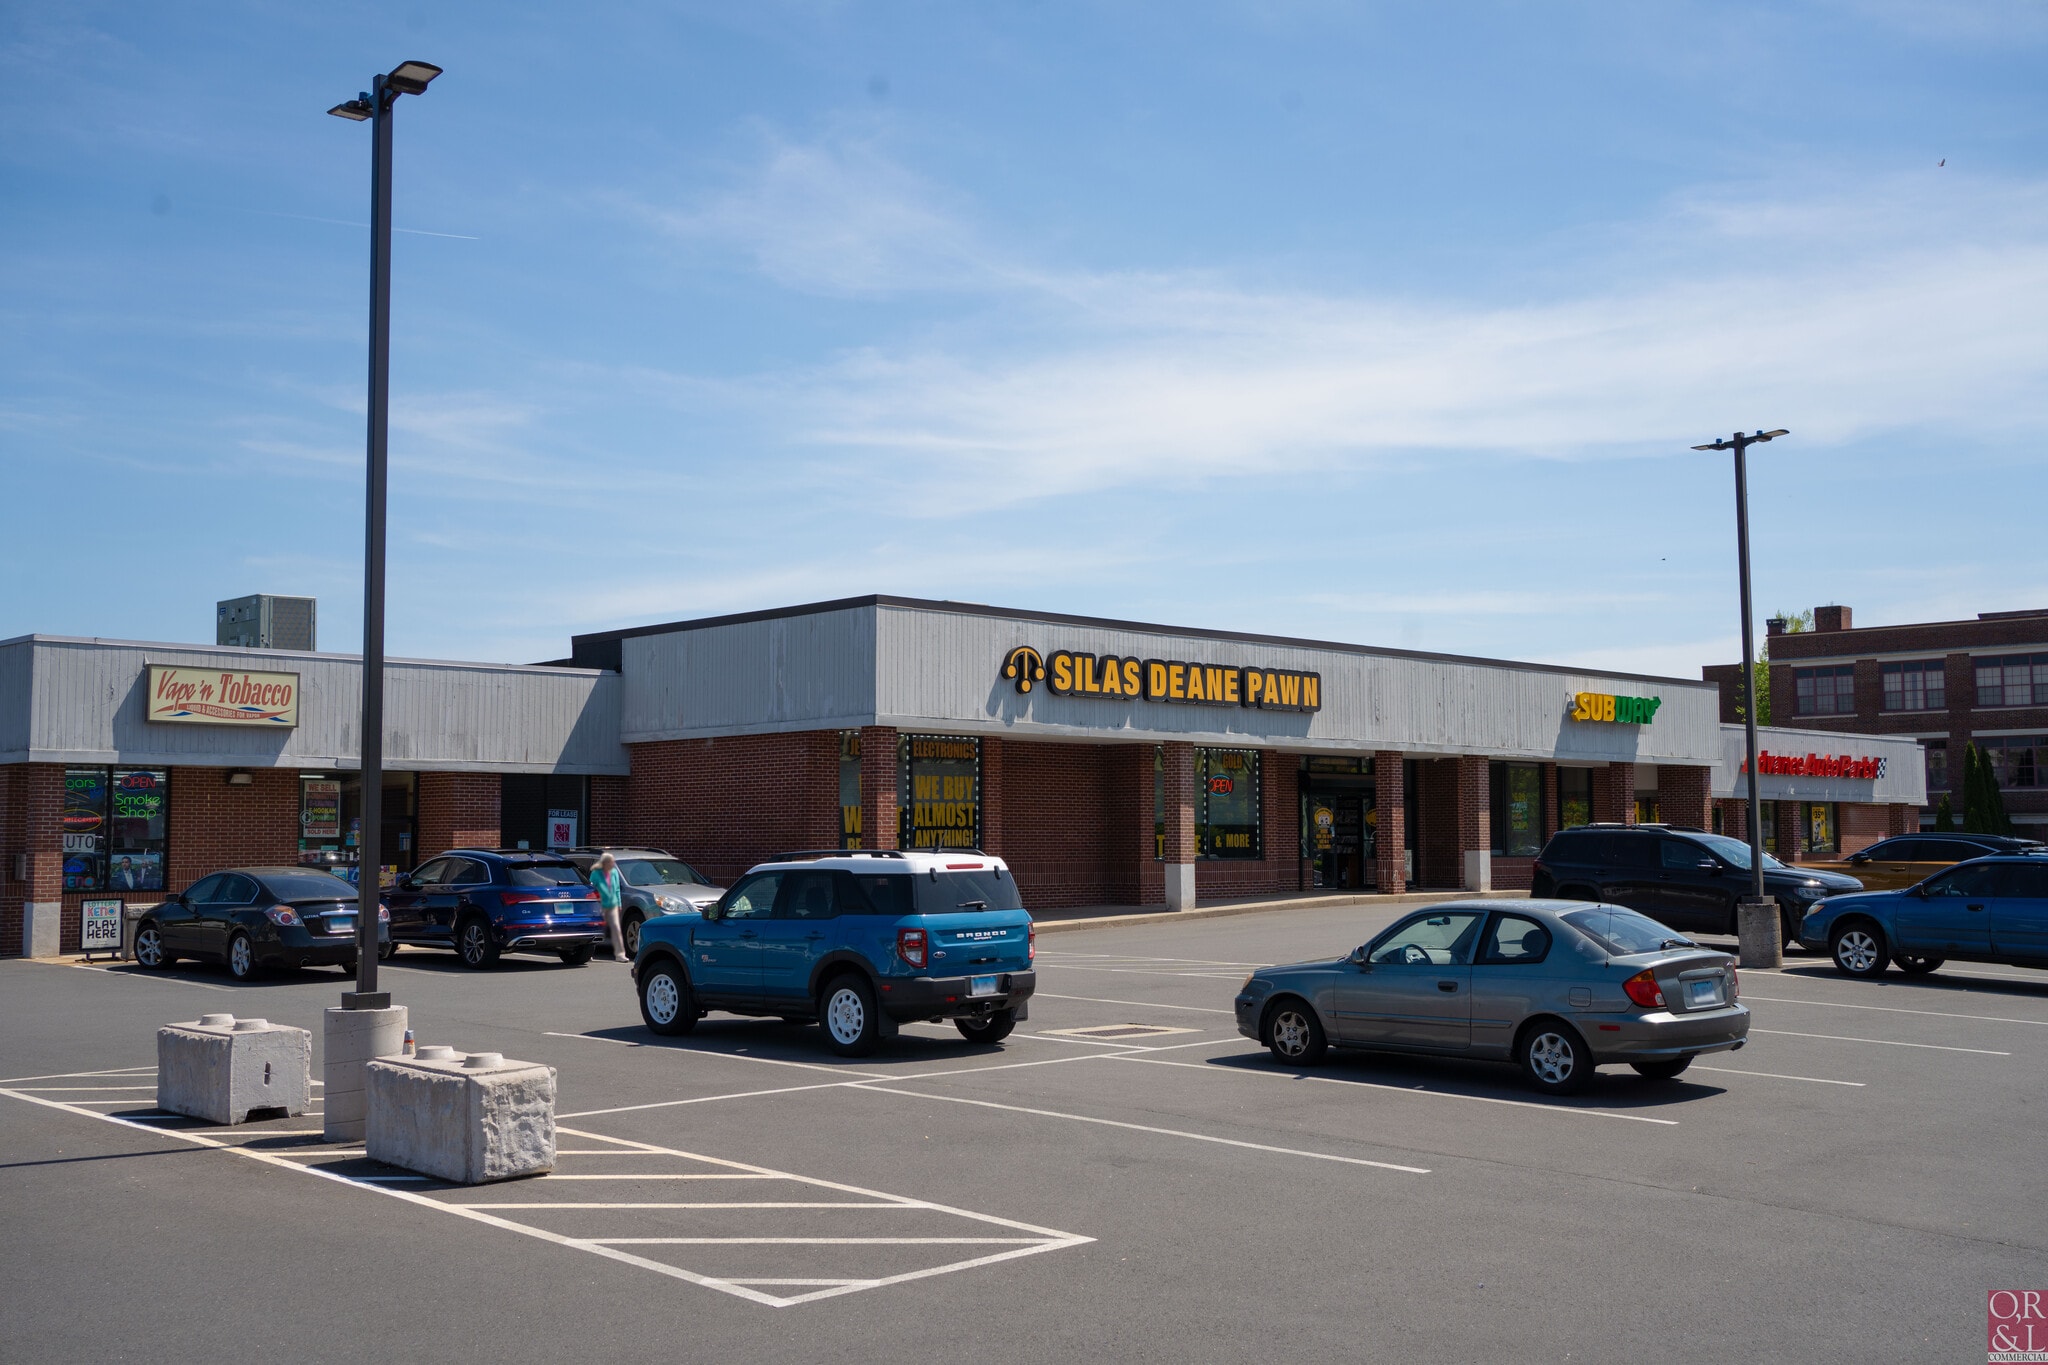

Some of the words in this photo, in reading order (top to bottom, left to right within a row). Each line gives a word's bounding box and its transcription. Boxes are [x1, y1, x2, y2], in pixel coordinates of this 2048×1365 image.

[1054, 654, 1141, 699] SILAS
[1150, 662, 1239, 702] DEANE
[1247, 671, 1318, 707] PAWN
[157, 670, 196, 711] Vape
[218, 673, 292, 706] Tobacco
[206, 705, 236, 718] ACCESSORIES
[1571, 692, 1661, 724] SUBWAY
[913, 741, 976, 759] ELECTRONICS
[1223, 754, 1243, 769] GOLD
[1804, 753, 1841, 777] Auto
[121, 775, 156, 789] OPEN
[320, 784, 336, 792] SELL
[915, 775, 940, 800] WE
[943, 776, 974, 800] BUY
[1208, 778, 1233, 793] OPEN
[115, 793, 160, 806] Smoke
[119, 806, 157, 820] Shop
[913, 802, 976, 827] ALMOST
[63, 835, 95, 849] UTO
[915, 830, 974, 848] ANYTHING!
[1226, 834, 1249, 847] MORE
[88, 907, 117, 916] KENO
[87, 920, 117, 929] PLAY
[87, 929, 117, 939] HERE
[956, 930, 1007, 938] BRONCO
